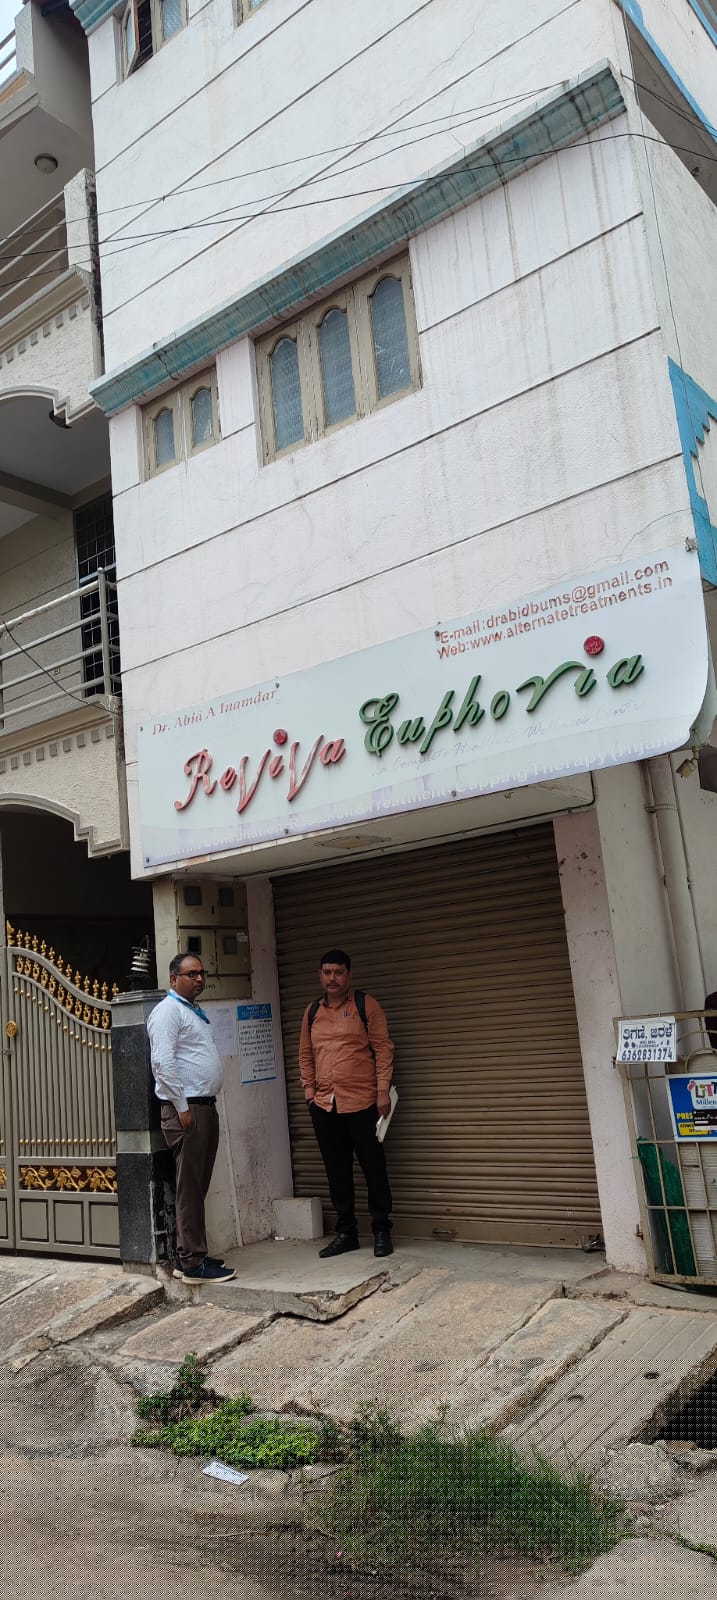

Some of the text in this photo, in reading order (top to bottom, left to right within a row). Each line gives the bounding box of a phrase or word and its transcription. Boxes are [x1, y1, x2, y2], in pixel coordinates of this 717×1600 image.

[152, 722, 171, 736] Dr.
[206, 706, 217, 720] A
[220, 690, 279, 715] Inamdar
[622, 1048, 672, 1060] 6362831374
